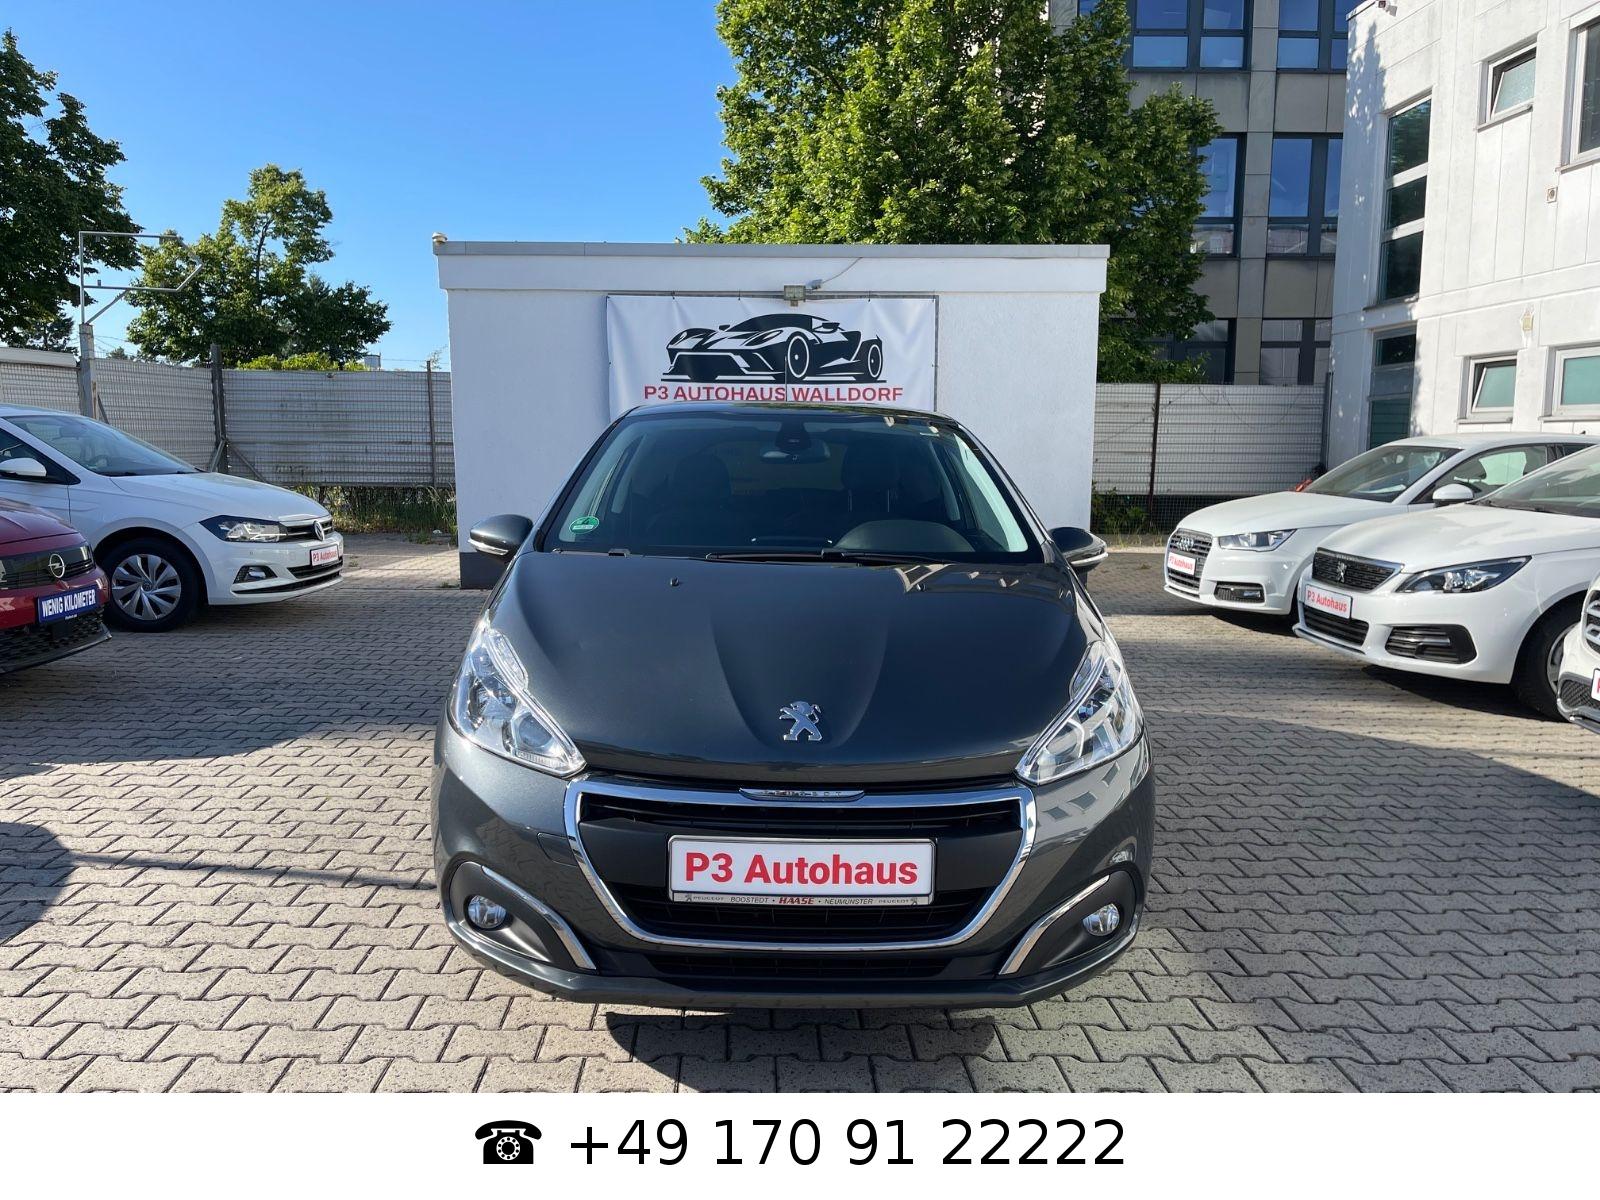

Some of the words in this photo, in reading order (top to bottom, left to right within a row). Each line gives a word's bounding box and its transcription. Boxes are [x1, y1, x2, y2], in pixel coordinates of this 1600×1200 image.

[644, 386, 668, 400] P3
[673, 386, 786, 401] AUTOHAUS
[792, 387, 903, 402] WALLDORF
[41, 596, 64, 618] WENIG
[64, 588, 97, 612] KILOMETER
[1306, 590, 1316, 602] P3
[1315, 593, 1348, 613] Autohaus
[685, 852, 733, 882] P3
[744, 854, 918, 885] Autohaus
[730, 896, 769, 904] BOOSTEDT
[778, 896, 815, 905] HAASE
